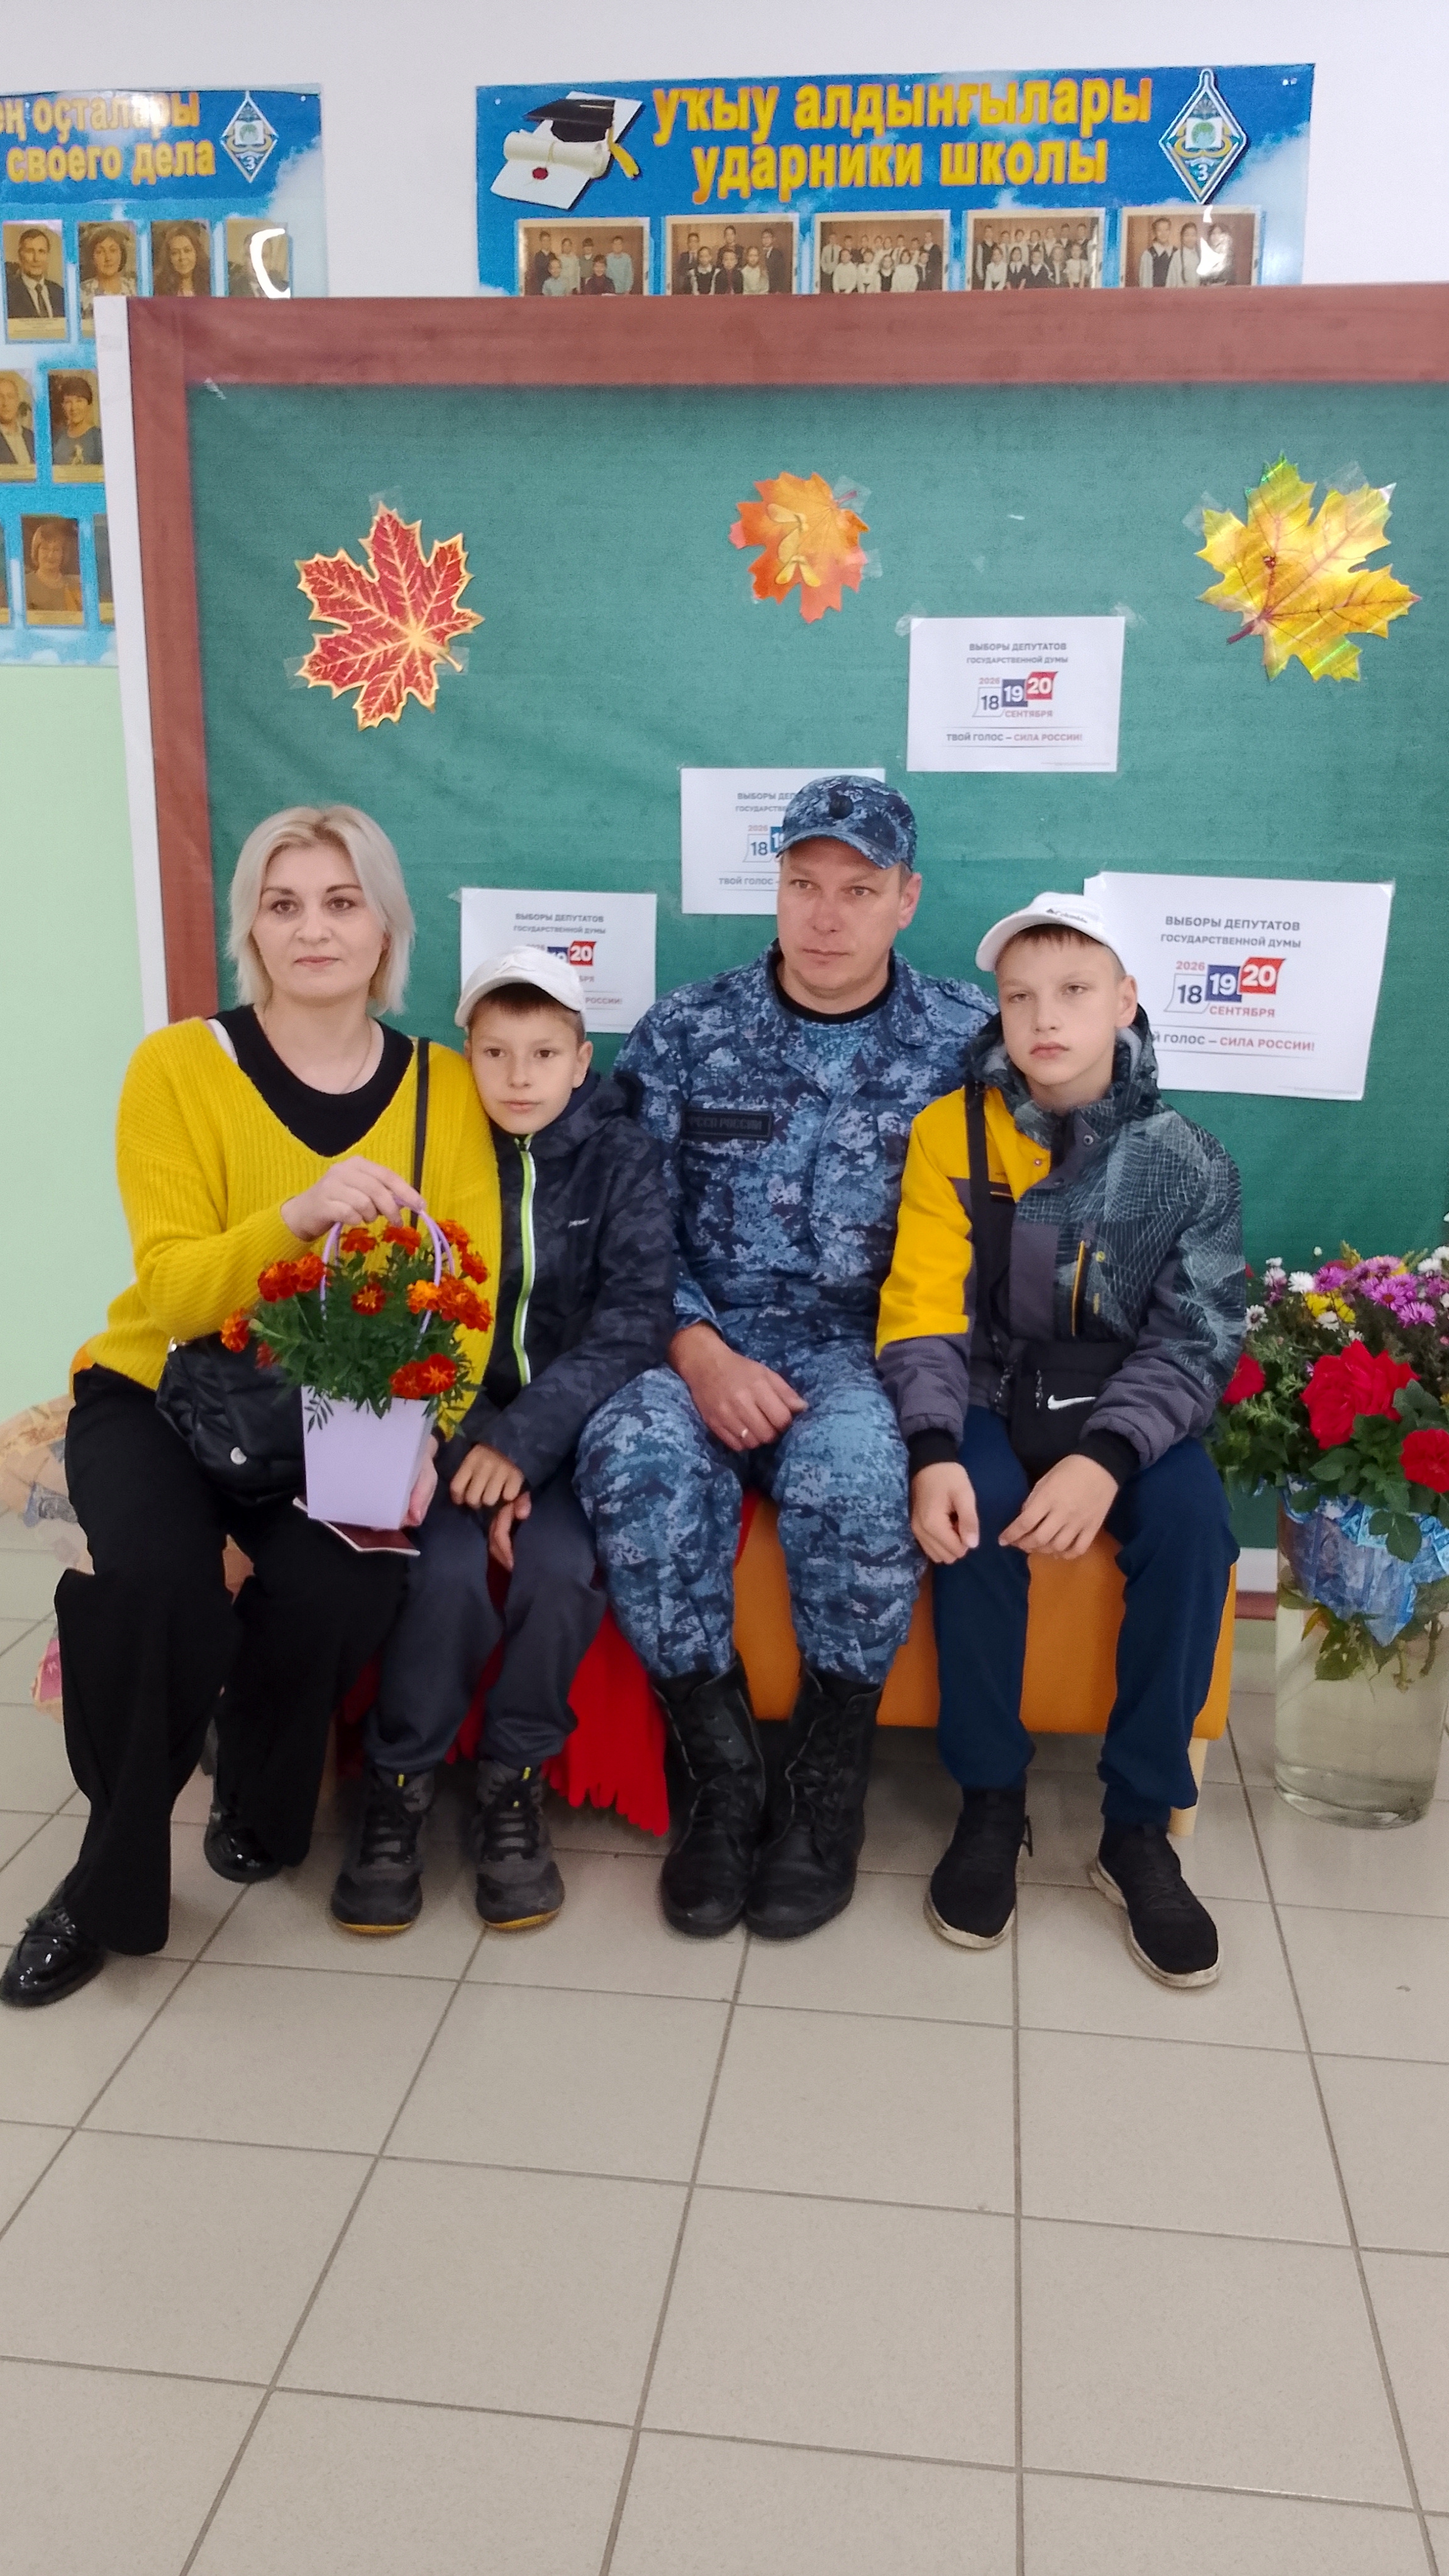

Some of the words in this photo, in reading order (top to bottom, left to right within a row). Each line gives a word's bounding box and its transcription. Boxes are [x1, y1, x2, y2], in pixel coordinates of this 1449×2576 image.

[794, 77, 1152, 139] алдынғылары
[6, 145, 122, 183] своего
[131, 140, 216, 186] дела
[245, 155, 256, 170] 3
[692, 141, 923, 204] ударники
[940, 139, 1108, 187] школы
[1197, 164, 1208, 181] 3
[969, 643, 1009, 651] ВЫБОРЫ
[1012, 643, 1067, 652] ДЕПУТАТОВ
[967, 656, 1043, 664] ГОСУДАРСТВЕННОЙ
[980, 696, 999, 710] 18
[1004, 685, 1023, 702] 19
[1027, 677, 1052, 694] 20
[1005, 709, 1053, 718] СЕНТЯБРЯ
[947, 732, 971, 741] ТВОЙ
[973, 733, 1004, 741] ГОЛОС
[1014, 733, 1039, 741] СИЛА
[1041, 733, 1083, 742] РОССИИ!
[751, 841, 768, 855] 18
[719, 877, 742, 885] ТВОЙ
[555, 914, 604, 923] ДЕПУТАТОВ
[1165, 916, 1221, 928] ВЫБОРЫ
[1224, 918, 1300, 931] ДЕПУТАТОВ
[513, 925, 583, 933] ГОСУДАРСТВЕННОЙ
[1160, 933, 1265, 947] ГОСУДАРСТВЕННОЙ
[1268, 938, 1301, 948] ДУМЫ
[570, 945, 592, 962] 20
[1175, 960, 1205, 972] 2026
[1178, 984, 1202, 1004] 18
[1209, 973, 1236, 995] 19
[1242, 963, 1276, 987] 20
[1209, 1006, 1275, 1017] СЕНТЯБРЯ
[1163, 1034, 1205, 1045] ГОЛОС
[1220, 1036, 1254, 1047] СИЛА
[1258, 1038, 1314, 1052] РОССИИ!
